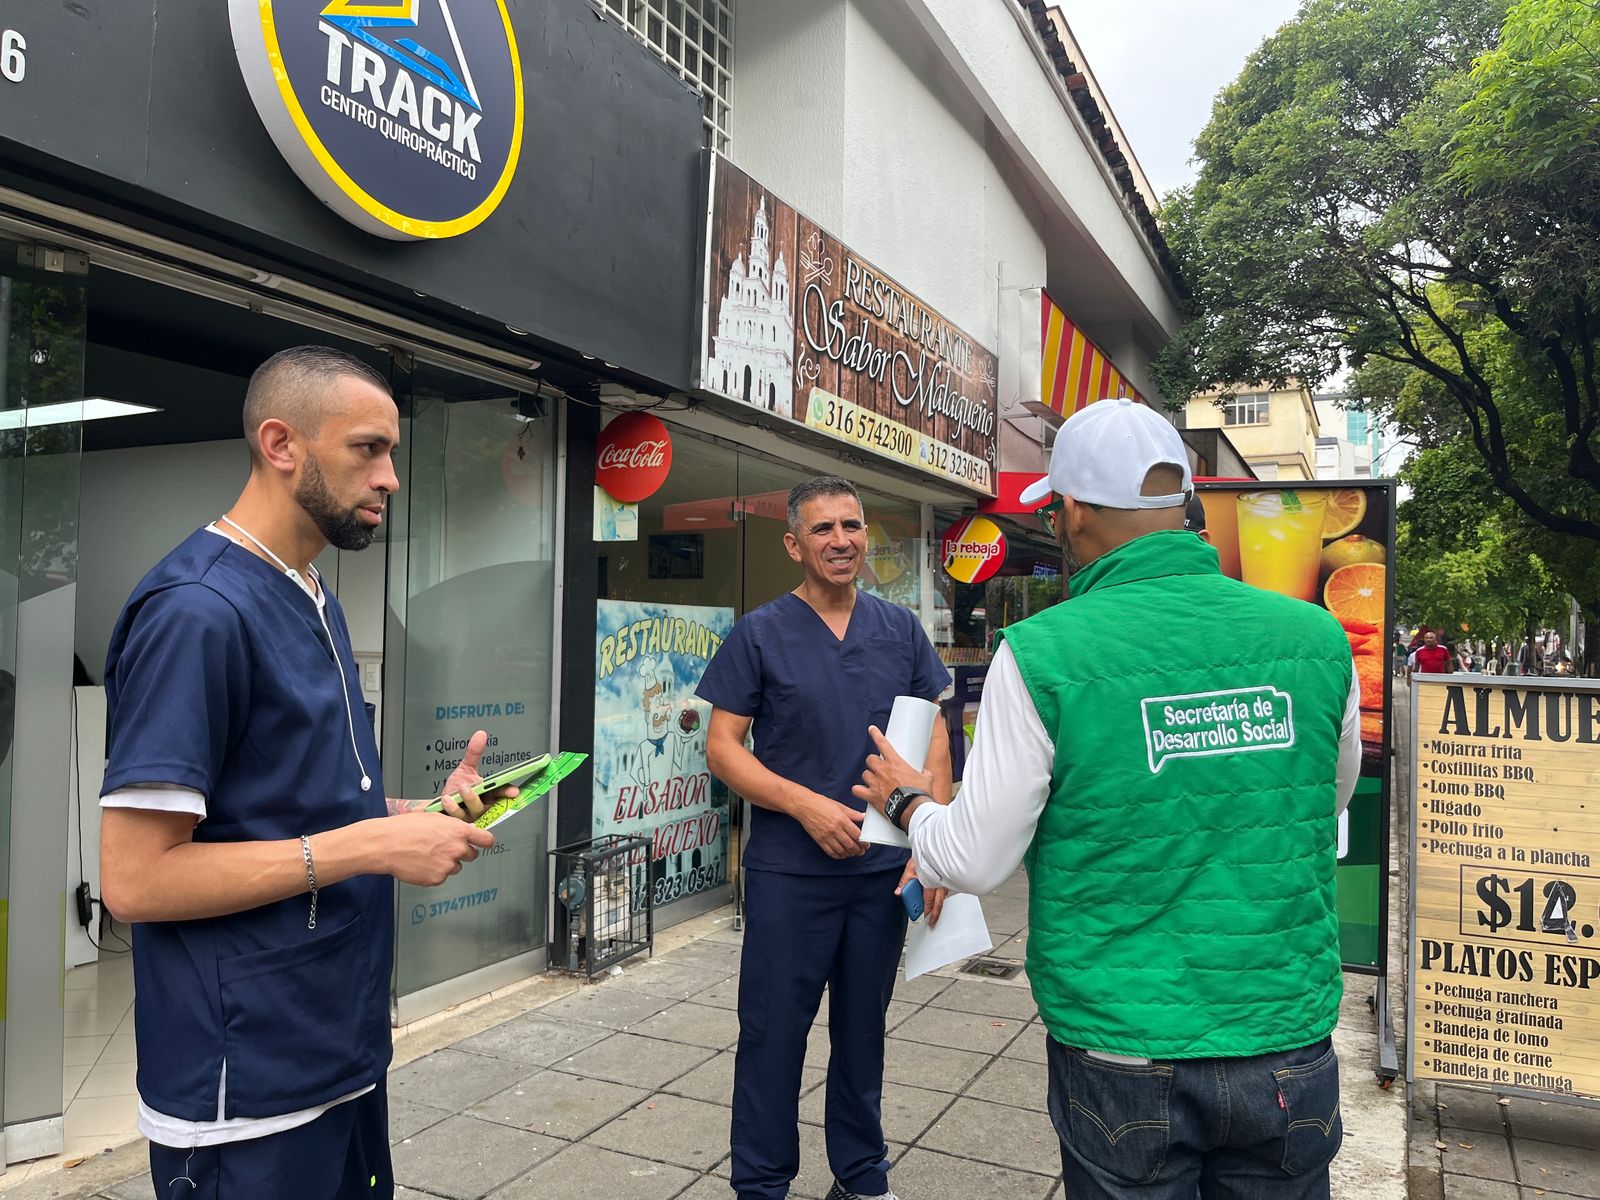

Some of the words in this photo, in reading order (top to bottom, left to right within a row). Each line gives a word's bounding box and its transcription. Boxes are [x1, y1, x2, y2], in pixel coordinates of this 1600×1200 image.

[1, 29, 26, 82] 6
[319, 20, 482, 163] TRACK
[321, 85, 377, 129] CENTRO
[379, 117, 476, 181] QUIROPRÁCTICO
[844, 257, 973, 375] RESTAURANTE
[803, 283, 892, 383] Sabor
[891, 349, 994, 439] Malagueño
[598, 440, 667, 470] Coca-Cola
[825, 401, 854, 434] 316
[857, 415, 912, 456] 5742300
[928, 444, 948, 470] 312
[949, 453, 987, 486] 3230541
[946, 540, 957, 553] la
[960, 542, 998, 559] rebaja
[599, 616, 724, 680] RESTAURANT
[436, 704, 502, 720] DISFRUTA
[505, 702, 525, 716] DE:
[1164, 698, 1249, 726] Secretaría
[1253, 696, 1273, 718] de
[1438, 685, 1600, 744] ALMUE
[1152, 723, 1238, 752] Desarrollo
[1241, 717, 1288, 742] Social
[481, 751, 531, 767] relajantes
[1431, 740, 1486, 758] Mojarra
[1491, 744, 1522, 760] frita
[1430, 760, 1498, 778] Costillitas
[1503, 765, 1534, 783] BBQ
[613, 785, 639, 821] EL
[643, 772, 710, 815] SABOR
[1430, 779, 1469, 796] Lomo
[1474, 783, 1505, 800] BBQ
[1430, 819, 1468, 836] Pollo
[1472, 822, 1504, 839] frito
[1430, 839, 1492, 860] Pechuga
[1497, 849, 1506, 860] a
[1511, 846, 1525, 862] la
[1530, 847, 1591, 867] plancha
[655, 872, 682, 905] 323
[688, 861, 720, 893] 0541
[429, 887, 498, 918] 3174711787
[1420, 939, 1534, 982] PLATOS
[1544, 953, 1600, 989] ESP
[1434, 982, 1491, 1002] Pechuga
[1496, 991, 1558, 1010] ranchera
[1433, 1001, 1491, 1021] Pechuga
[1495, 1008, 1563, 1030] gratinada
[1433, 1020, 1489, 1040] Bandeja
[1493, 1028, 1509, 1043] de
[1514, 1030, 1549, 1048] lomo
[1433, 1039, 1488, 1060] Bandeja
[1493, 1047, 1509, 1062] de
[1513, 1051, 1552, 1068] carne
[1432, 1058, 1488, 1079] Bandeja
[1492, 1067, 1509, 1082] de
[1513, 1071, 1573, 1092] pechuga
